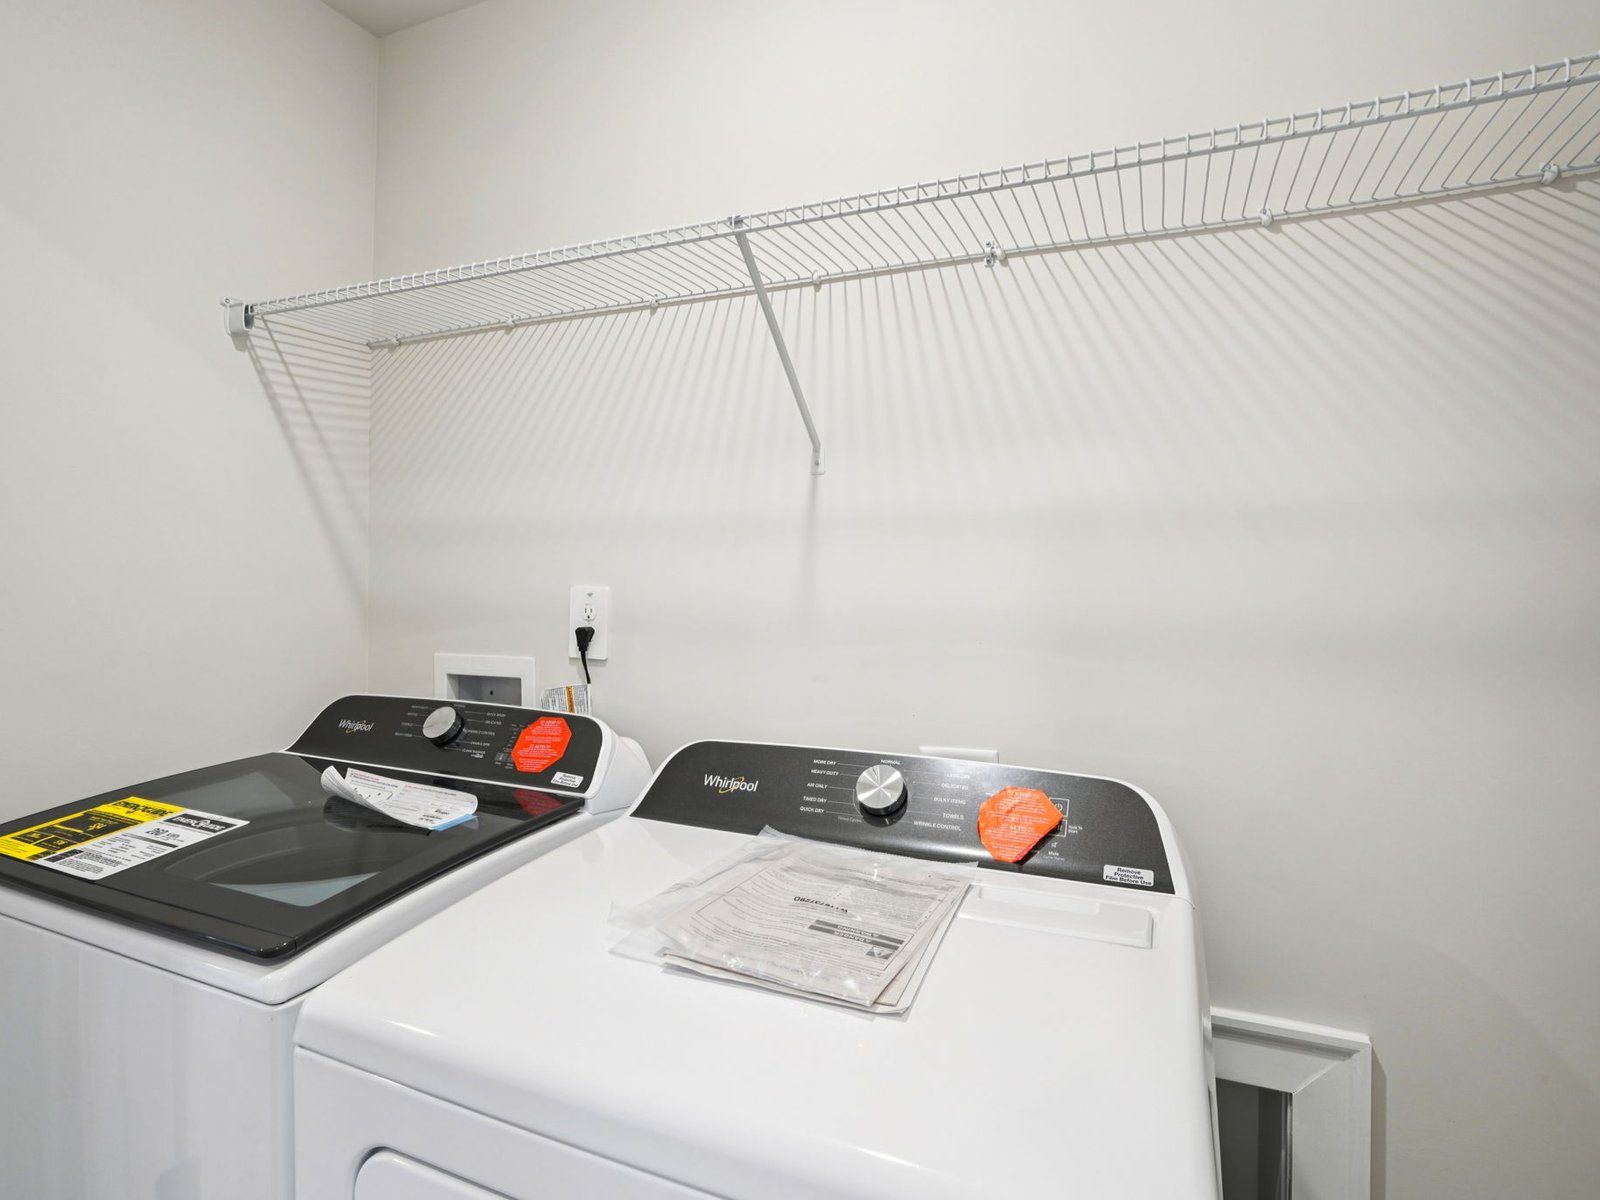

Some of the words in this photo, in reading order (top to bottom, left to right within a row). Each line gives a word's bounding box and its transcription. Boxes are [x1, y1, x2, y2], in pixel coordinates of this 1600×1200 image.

[338, 719, 375, 732] Whirlpool
[704, 774, 759, 792] Whirlpool
[1117, 867, 1141, 875] Remove
[1114, 872, 1144, 880] Protective
[1119, 877, 1139, 885] Before
